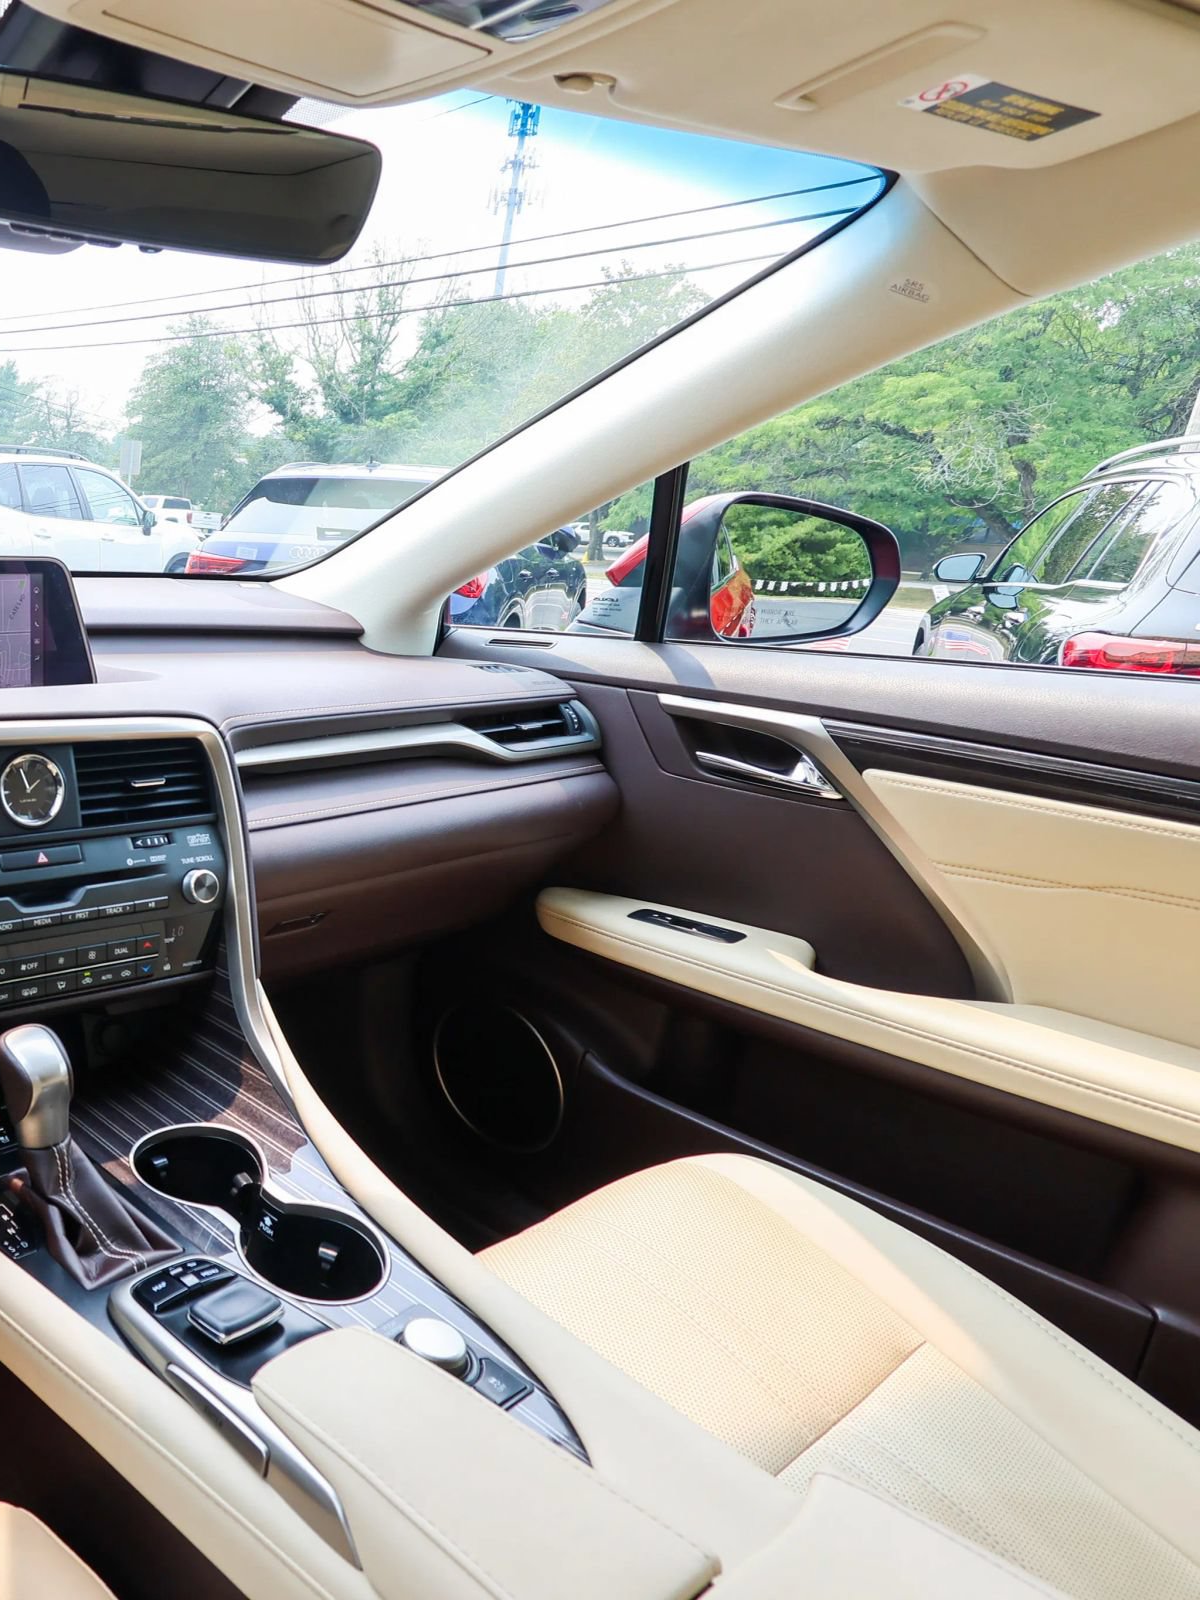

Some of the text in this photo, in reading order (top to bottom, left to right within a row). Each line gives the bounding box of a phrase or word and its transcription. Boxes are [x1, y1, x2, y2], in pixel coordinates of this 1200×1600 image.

[904, 278, 926, 290] SRS
[890, 284, 929, 302] AIRBAG
[105, 906, 123, 914] TRACK
[75, 911, 89, 919] PRST
[33, 918, 52, 926] MEDIA
[114, 947, 129, 955] DUAL
[27, 961, 39, 970] OFF
[151, 1281, 167, 1292] MAP
